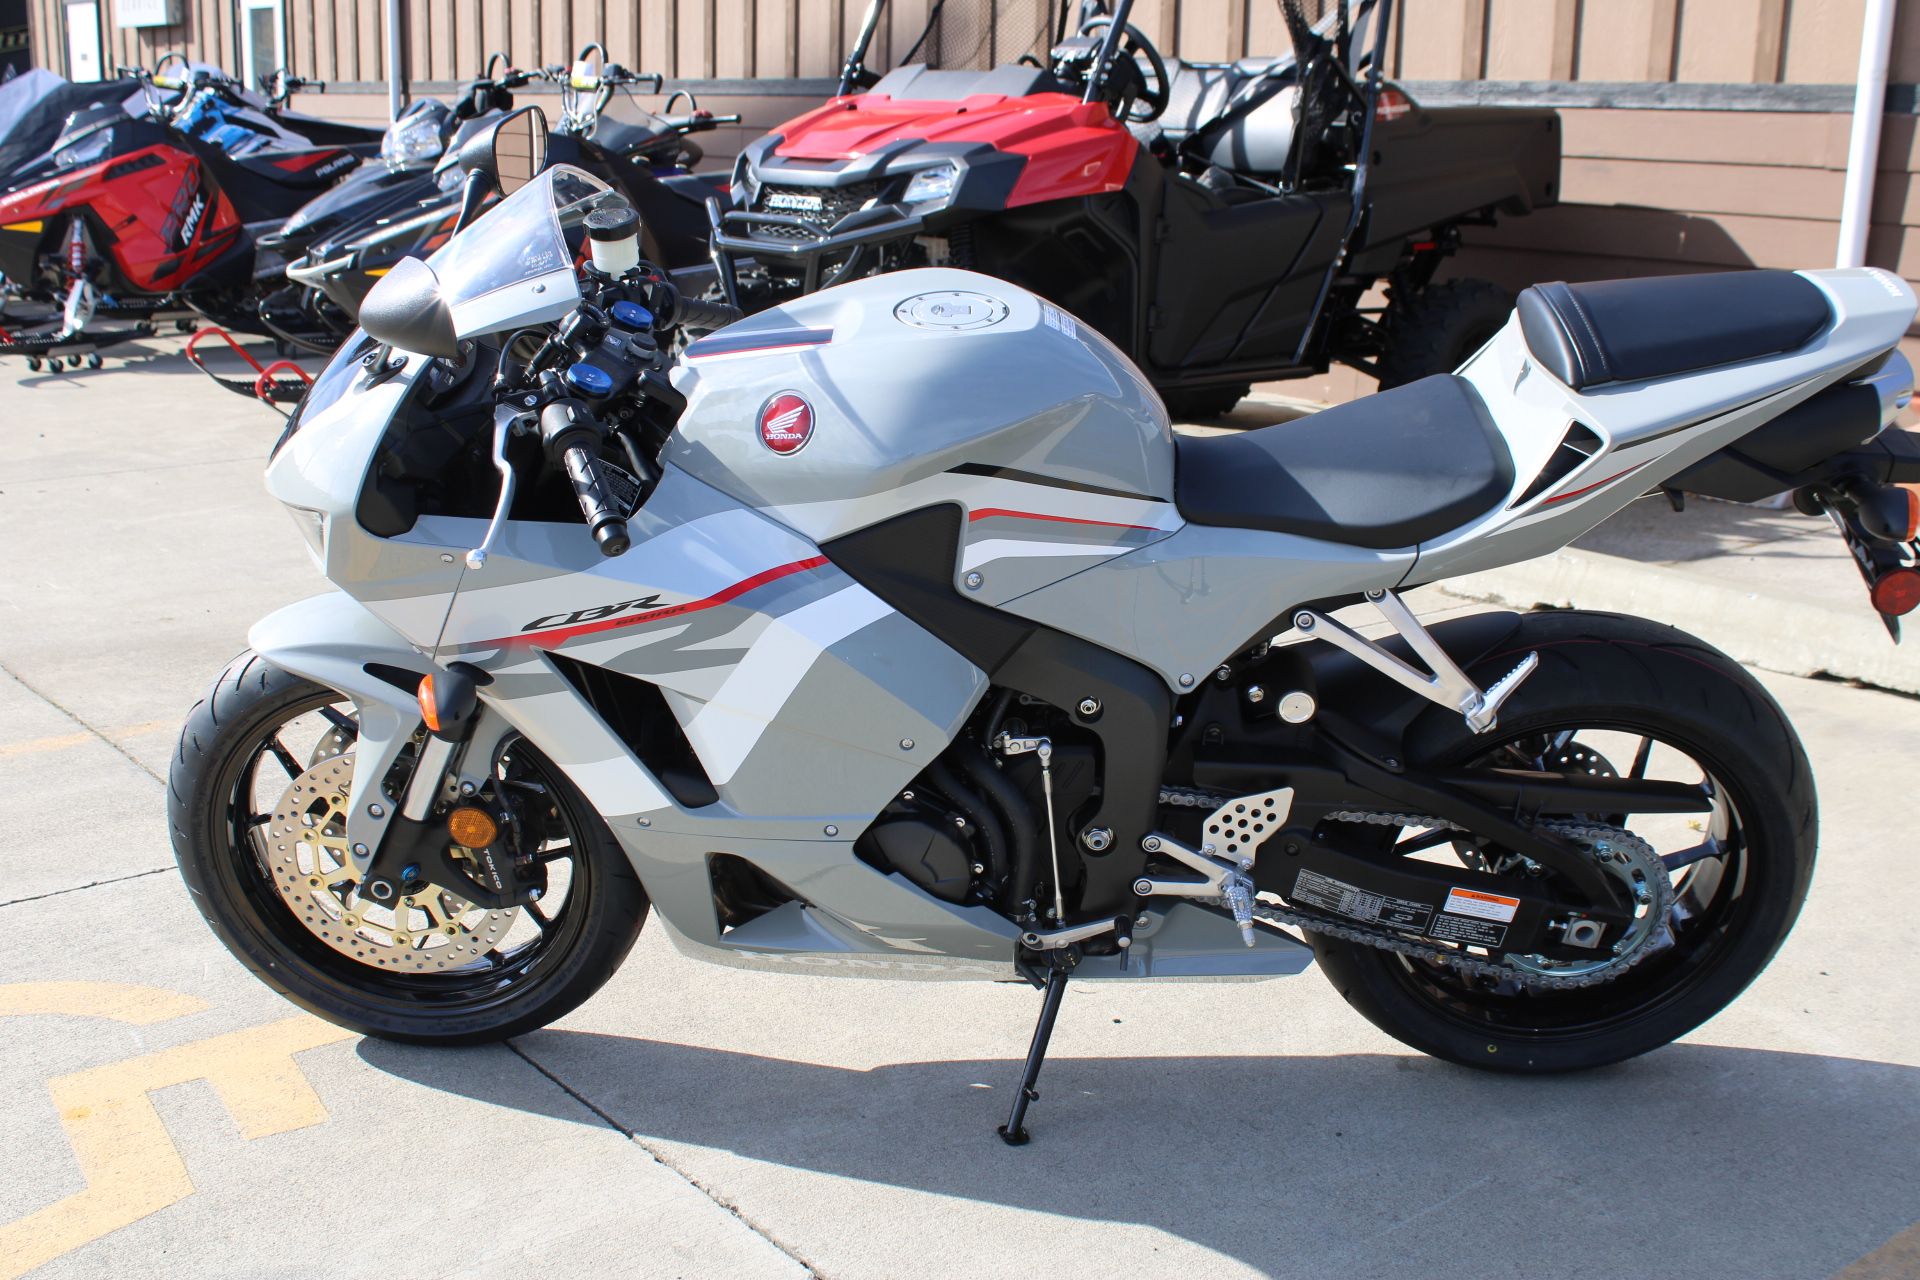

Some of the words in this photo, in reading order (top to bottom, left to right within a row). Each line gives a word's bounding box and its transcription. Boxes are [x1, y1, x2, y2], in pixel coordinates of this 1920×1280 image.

[180, 193, 205, 246] RMK
[521, 594, 672, 632] CBR
[483, 848, 503, 889] TOKICO
